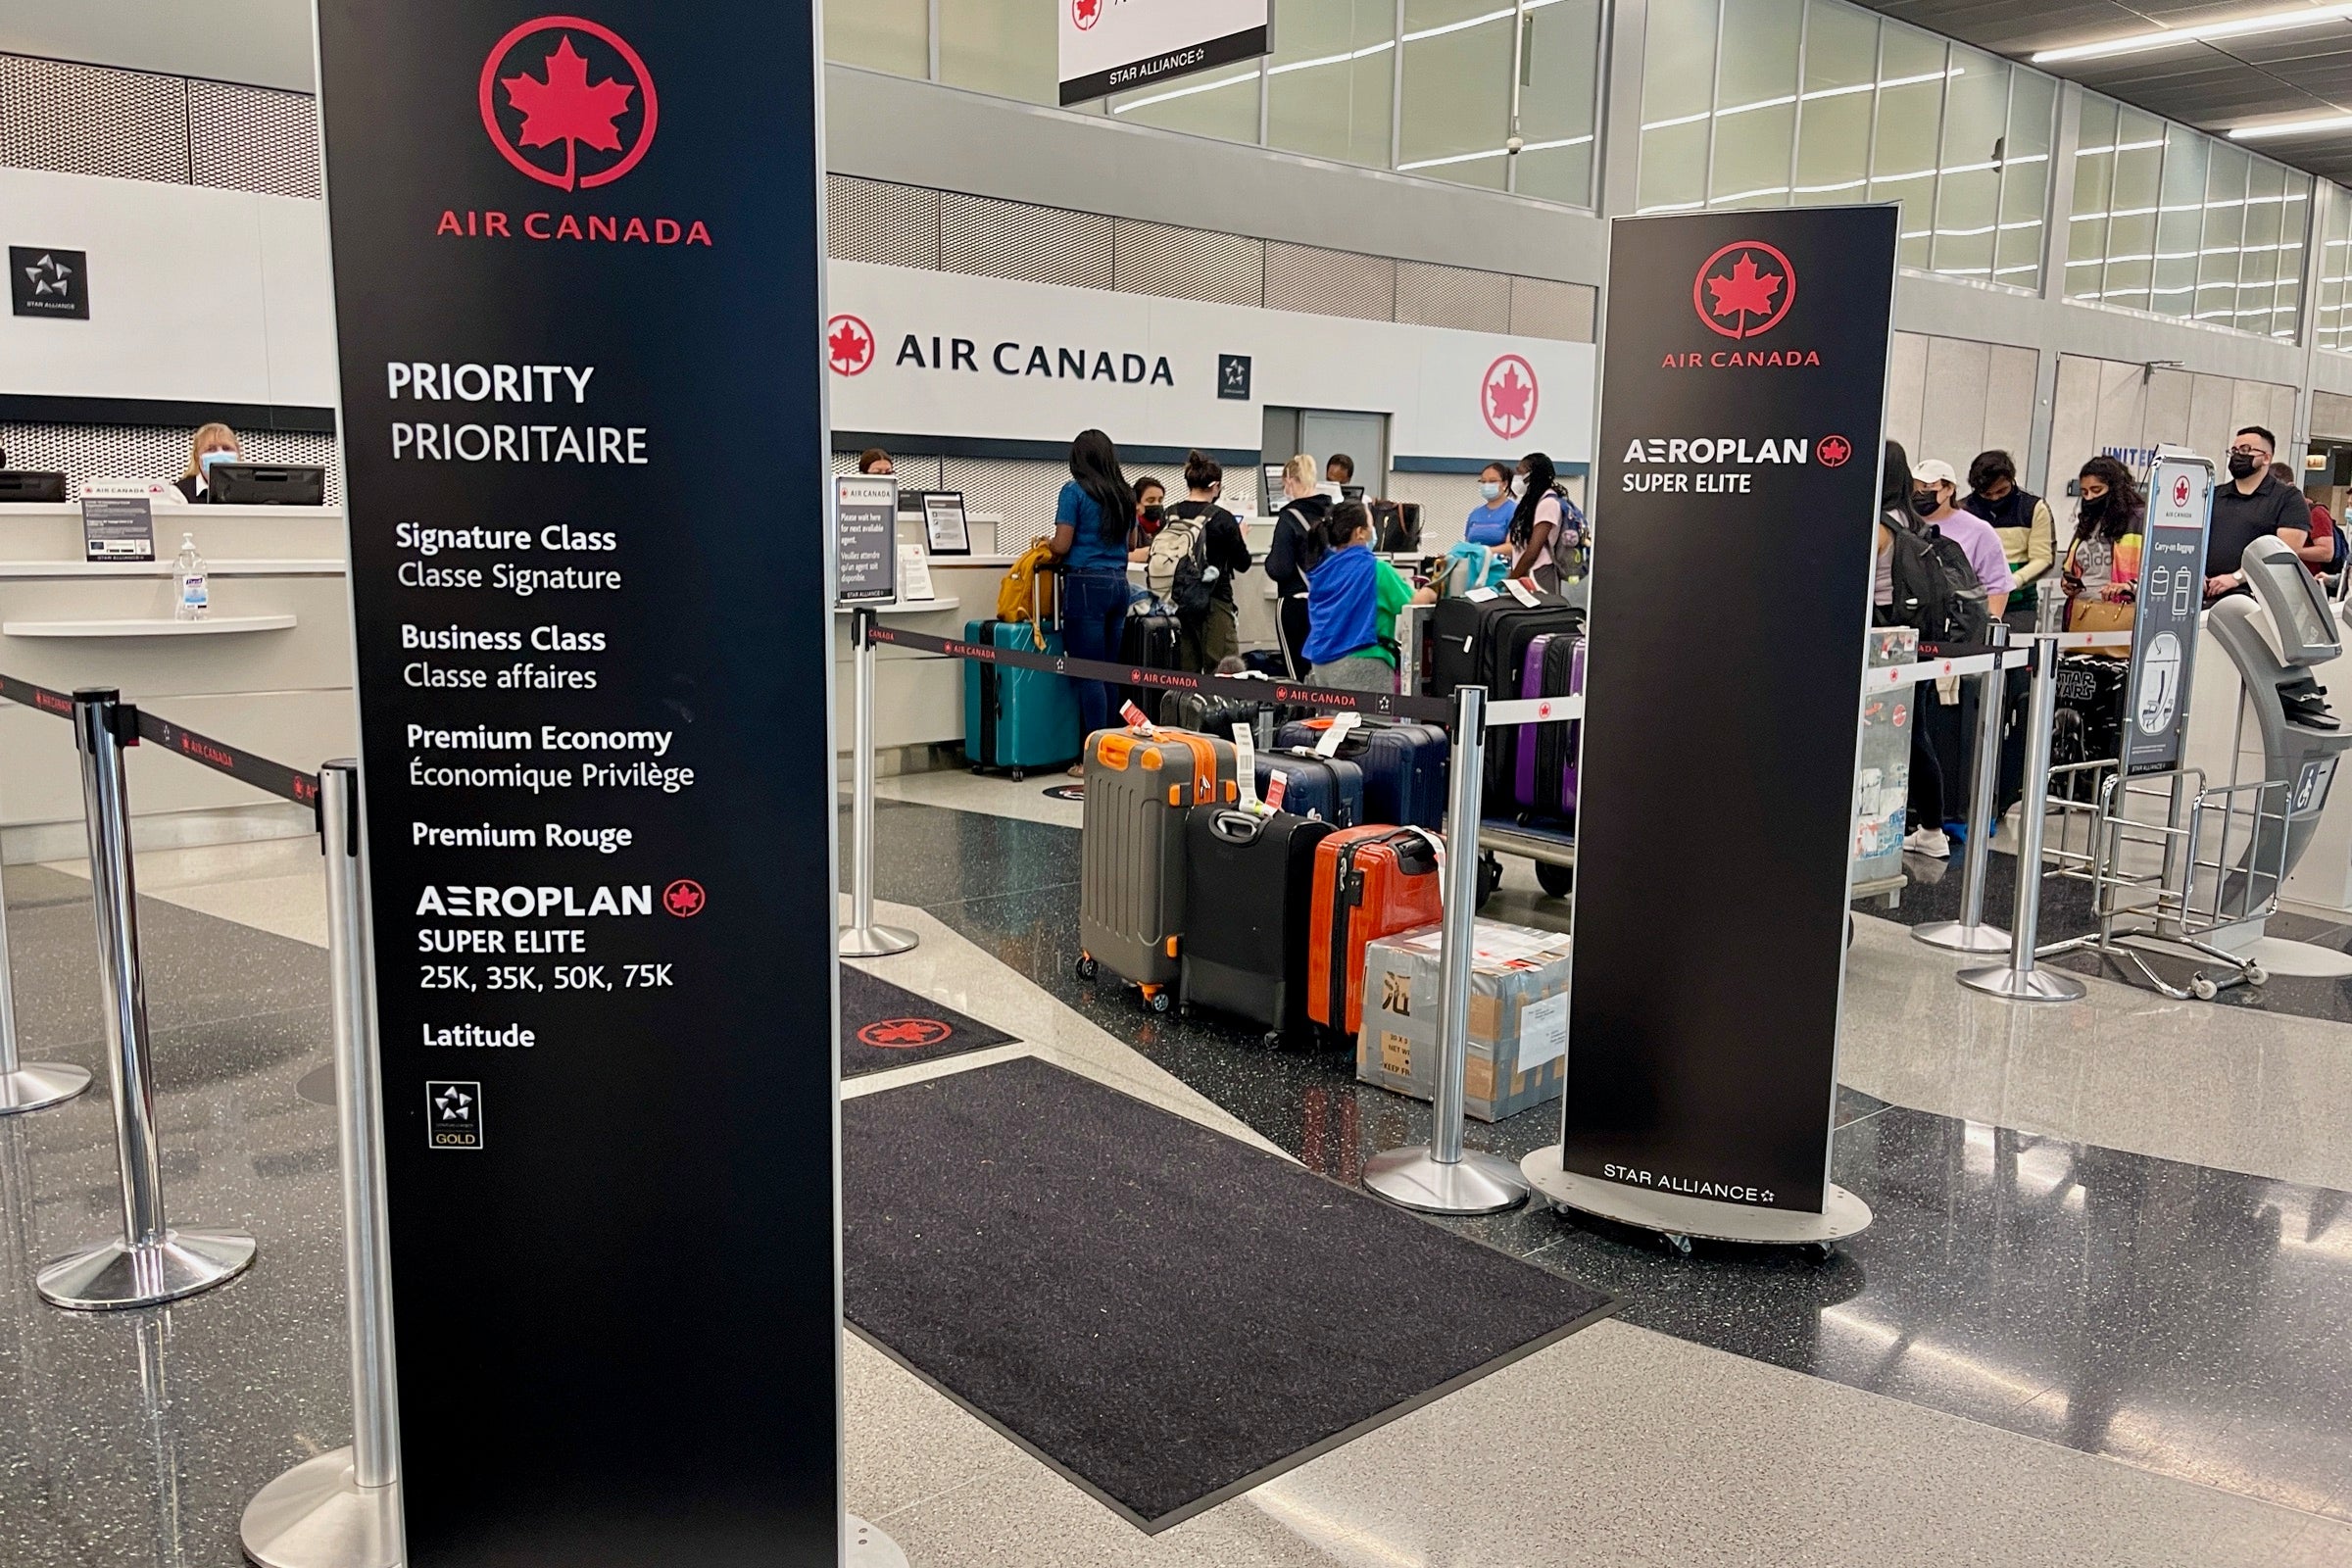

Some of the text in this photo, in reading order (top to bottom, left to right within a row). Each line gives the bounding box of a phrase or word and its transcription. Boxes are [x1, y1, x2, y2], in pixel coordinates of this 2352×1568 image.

[1109, 50, 1196, 85] STAR ALLIANCE
[437, 210, 713, 246] AIR CANADA
[896, 333, 1175, 386] AIR CANADA
[1661, 350, 1821, 368] AIR CANADA
[387, 362, 595, 404] PRIORITY
[391, 422, 649, 465] PRIORITAIRE
[1623, 438, 1808, 465] AEROPLAN
[1622, 472, 1752, 494] SUPER ELITE
[840, 513, 881, 521] Please wait here
[840, 523, 884, 533] for next available
[395, 521, 617, 557] Signature Class
[2154, 541, 2195, 556] Carry-on Baggage
[855, 563, 869, 573] agent
[859, 550, 881, 560] attendre
[2082, 552, 2113, 567] dida
[397, 560, 622, 597] Classe Signature
[401, 623, 607, 652] Business Class
[868, 629, 895, 642] CANADA
[954, 645, 996, 660] AIR CANADA
[1919, 644, 1939, 655] ADA
[403, 662, 598, 689] Classe affaires
[1143, 673, 1199, 688] AIR CANADA
[1290, 690, 1356, 707] AIR CANADA
[407, 723, 673, 757] Premium Economy
[191, 740, 234, 768] AIR CANADA
[410, 756, 695, 795] Économique Privilège
[413, 821, 633, 854] Premium Rouge
[416, 884, 653, 917] AEROPLAN
[417, 928, 586, 955] SUPER ELITE
[419, 963, 673, 993] 25K, 35K, 50K, 75K
[422, 1022, 536, 1048] Latitude
[1383, 1061, 1400, 1073] KEEP
[435, 1133, 476, 1145] GOLD
[1603, 1163, 1758, 1201] STAR ALLIANCE
